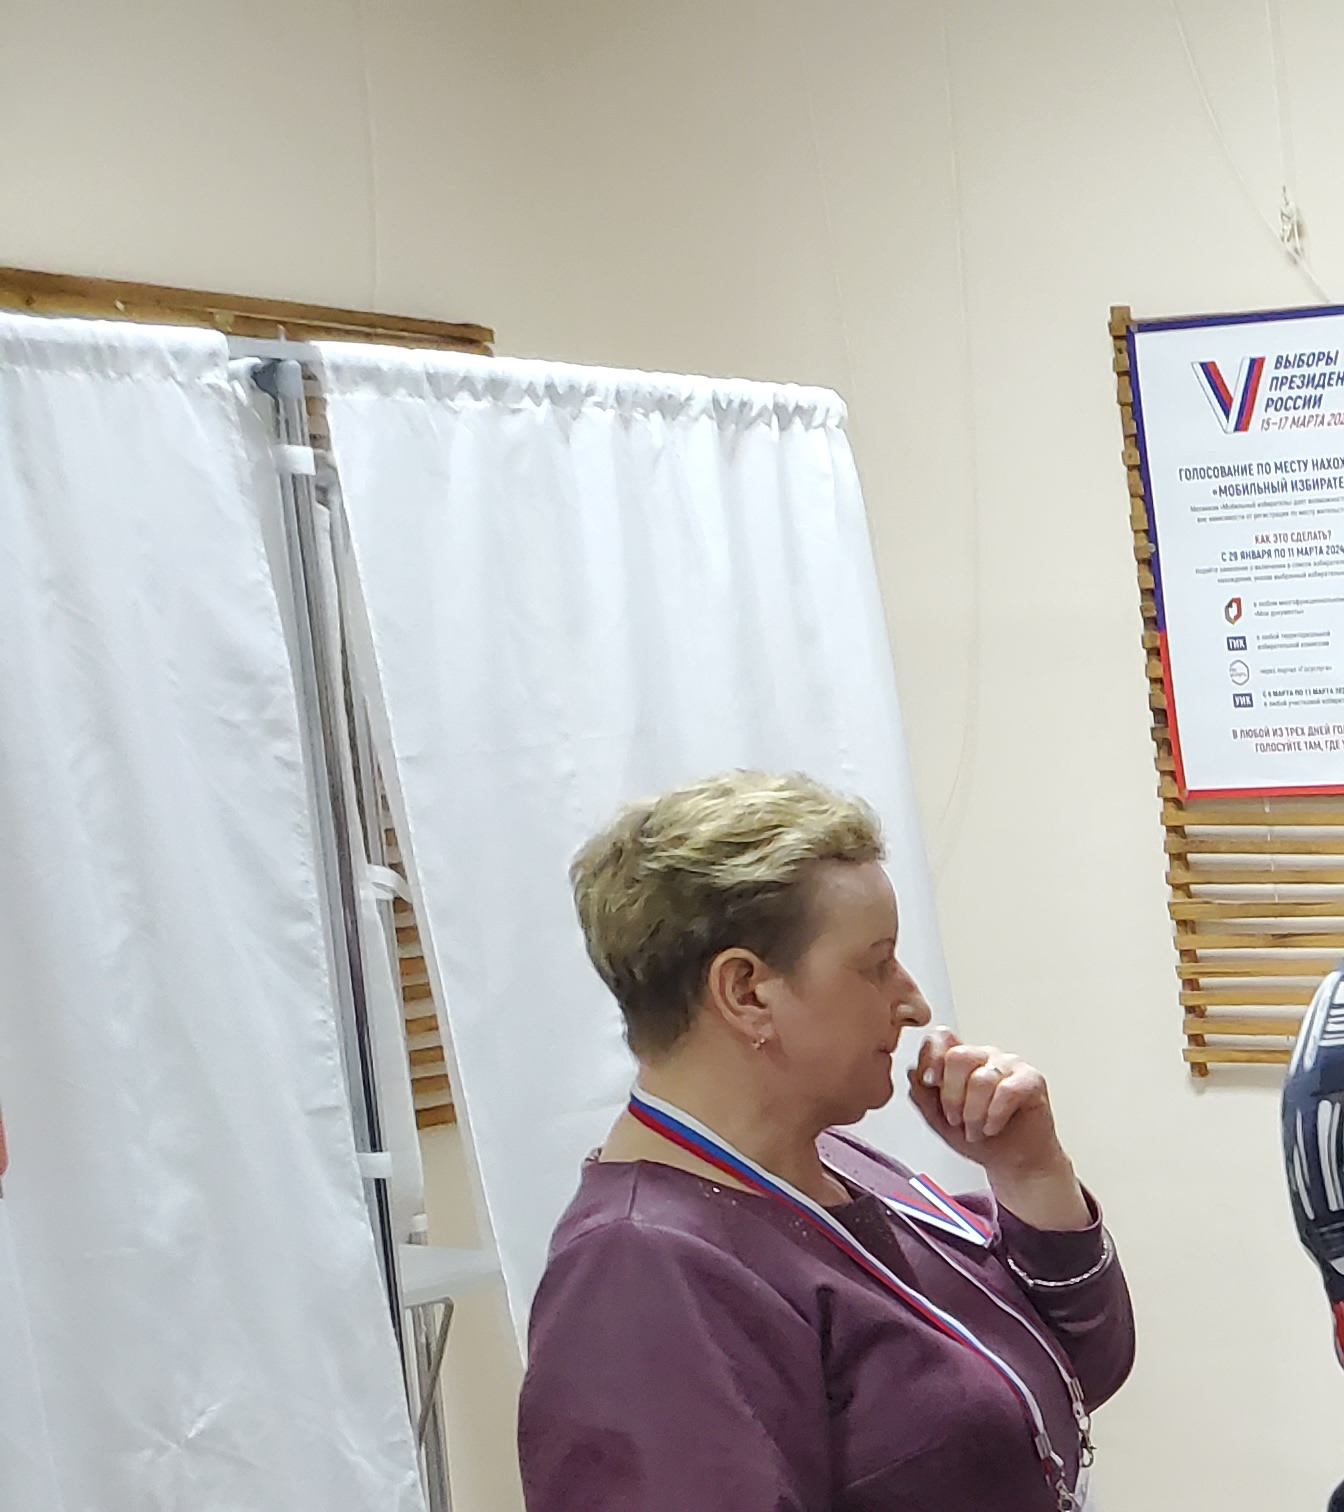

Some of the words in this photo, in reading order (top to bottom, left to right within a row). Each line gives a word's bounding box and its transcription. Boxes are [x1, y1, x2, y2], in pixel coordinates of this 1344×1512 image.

[1273, 350, 1339, 370] ВЫБОРЫ
[1264, 394, 1324, 412] РОССИИ
[1289, 413, 1326, 428] МАРТА
[1178, 463, 1254, 481] ГОЛОСОВАНИЕ
